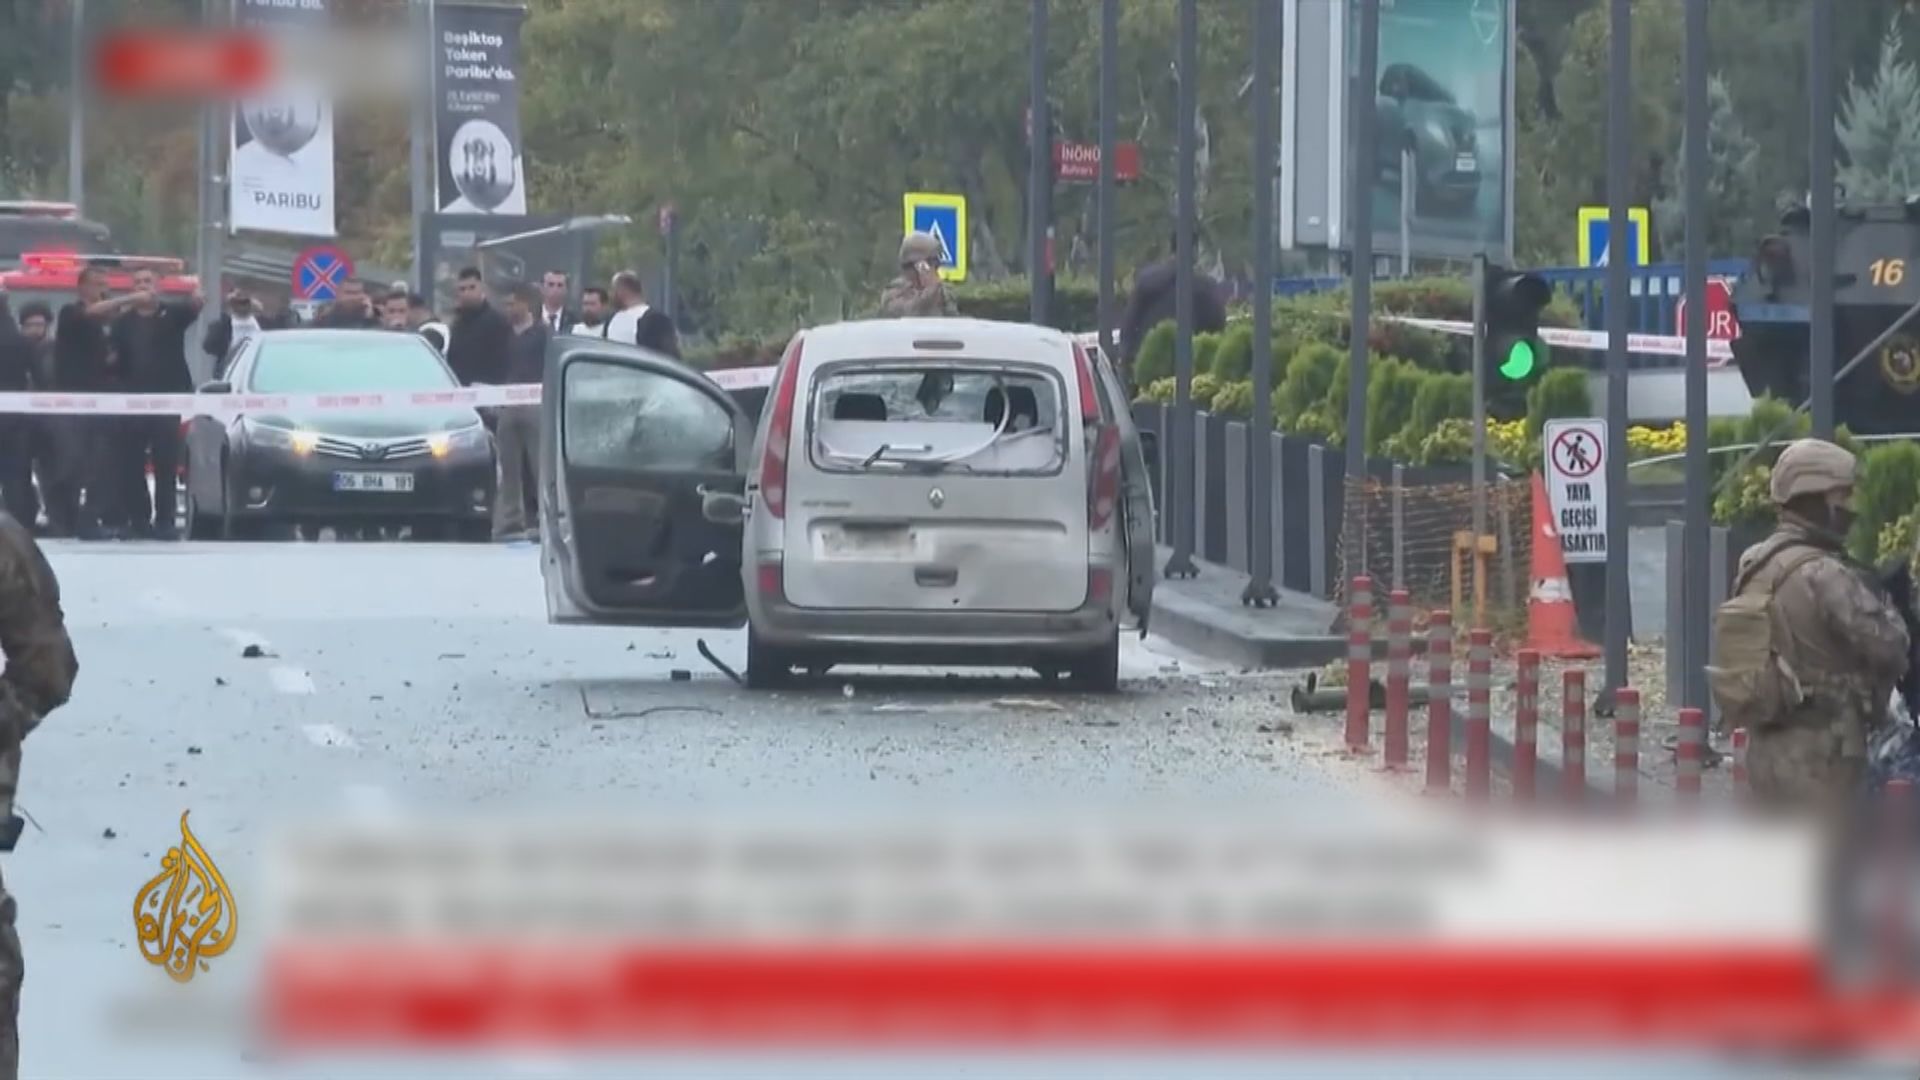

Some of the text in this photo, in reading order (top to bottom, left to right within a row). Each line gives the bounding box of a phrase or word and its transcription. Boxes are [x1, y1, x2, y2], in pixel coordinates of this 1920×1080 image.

[445, 48, 487, 61] Token
[1870, 258, 1904, 286] 16
[1566, 483, 1592, 501] YAYA
[1561, 504, 1597, 530] GEÇİŞİ
